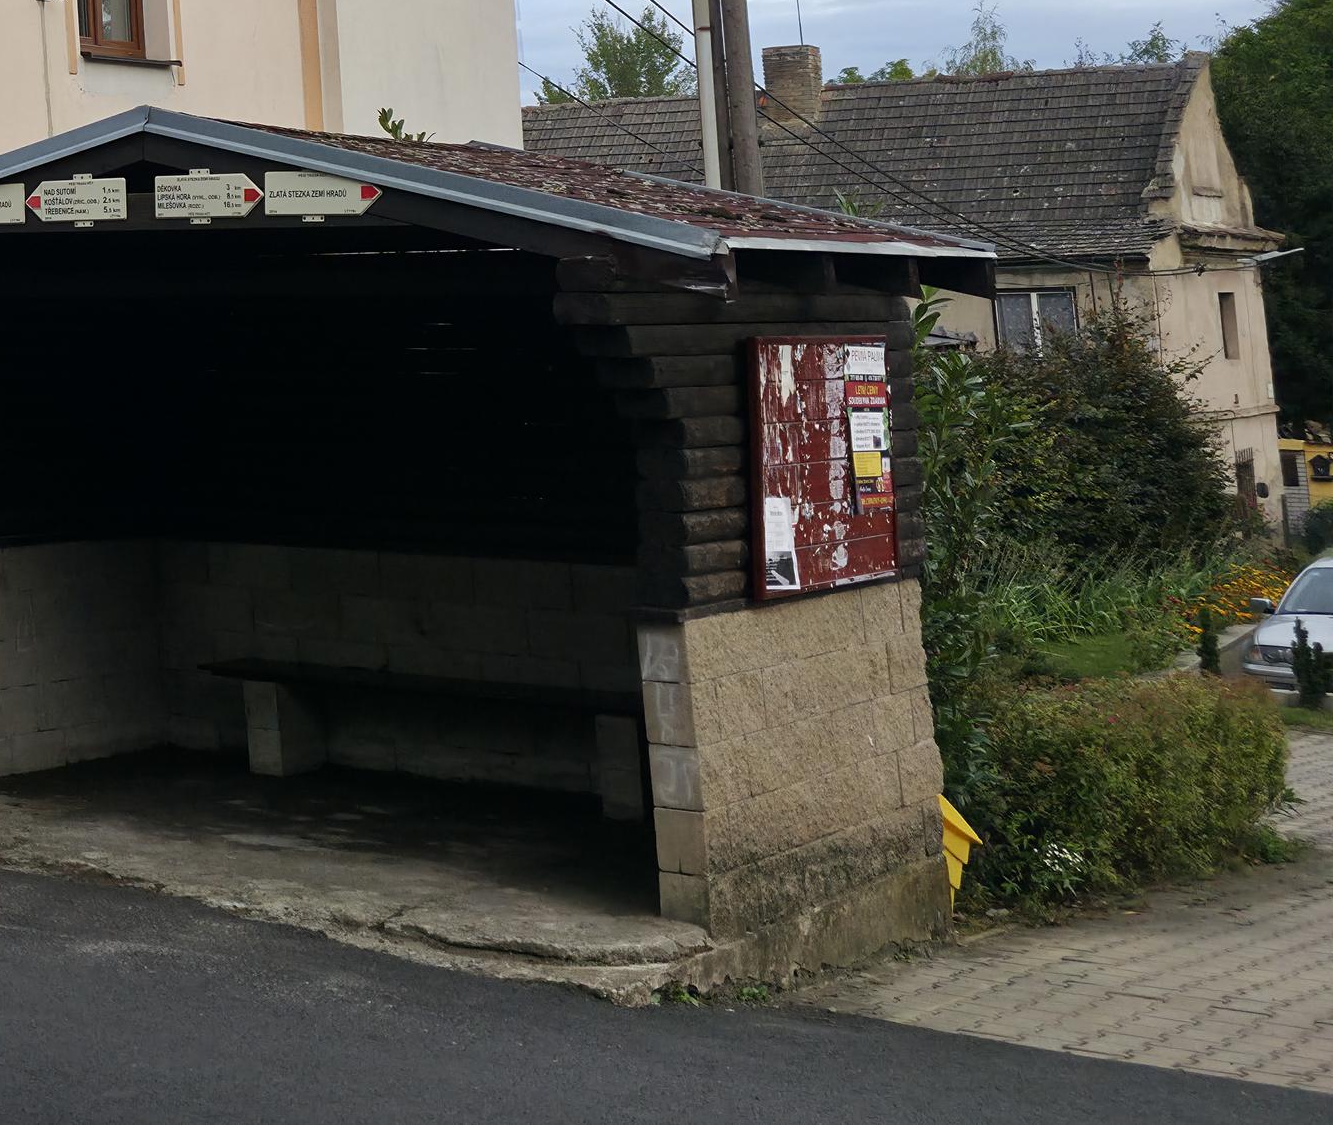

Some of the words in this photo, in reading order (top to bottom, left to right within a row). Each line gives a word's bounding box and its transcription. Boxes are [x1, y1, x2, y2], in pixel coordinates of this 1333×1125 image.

[56, 188, 77, 196] SUTOMÍ
[269, 189, 287, 198] ZLATÁ
[288, 190, 311, 198] STEZKA
[311, 189, 325, 198] ZEMÍ
[326, 188, 347, 198] HRADŮ
[157, 193, 175, 201] LIPSKÁ
[44, 197, 73, 206] KOŠŤÁLOV
[158, 201, 187, 209] MILEŠOVKA
[45, 207, 74, 215] TŘEBENICE
